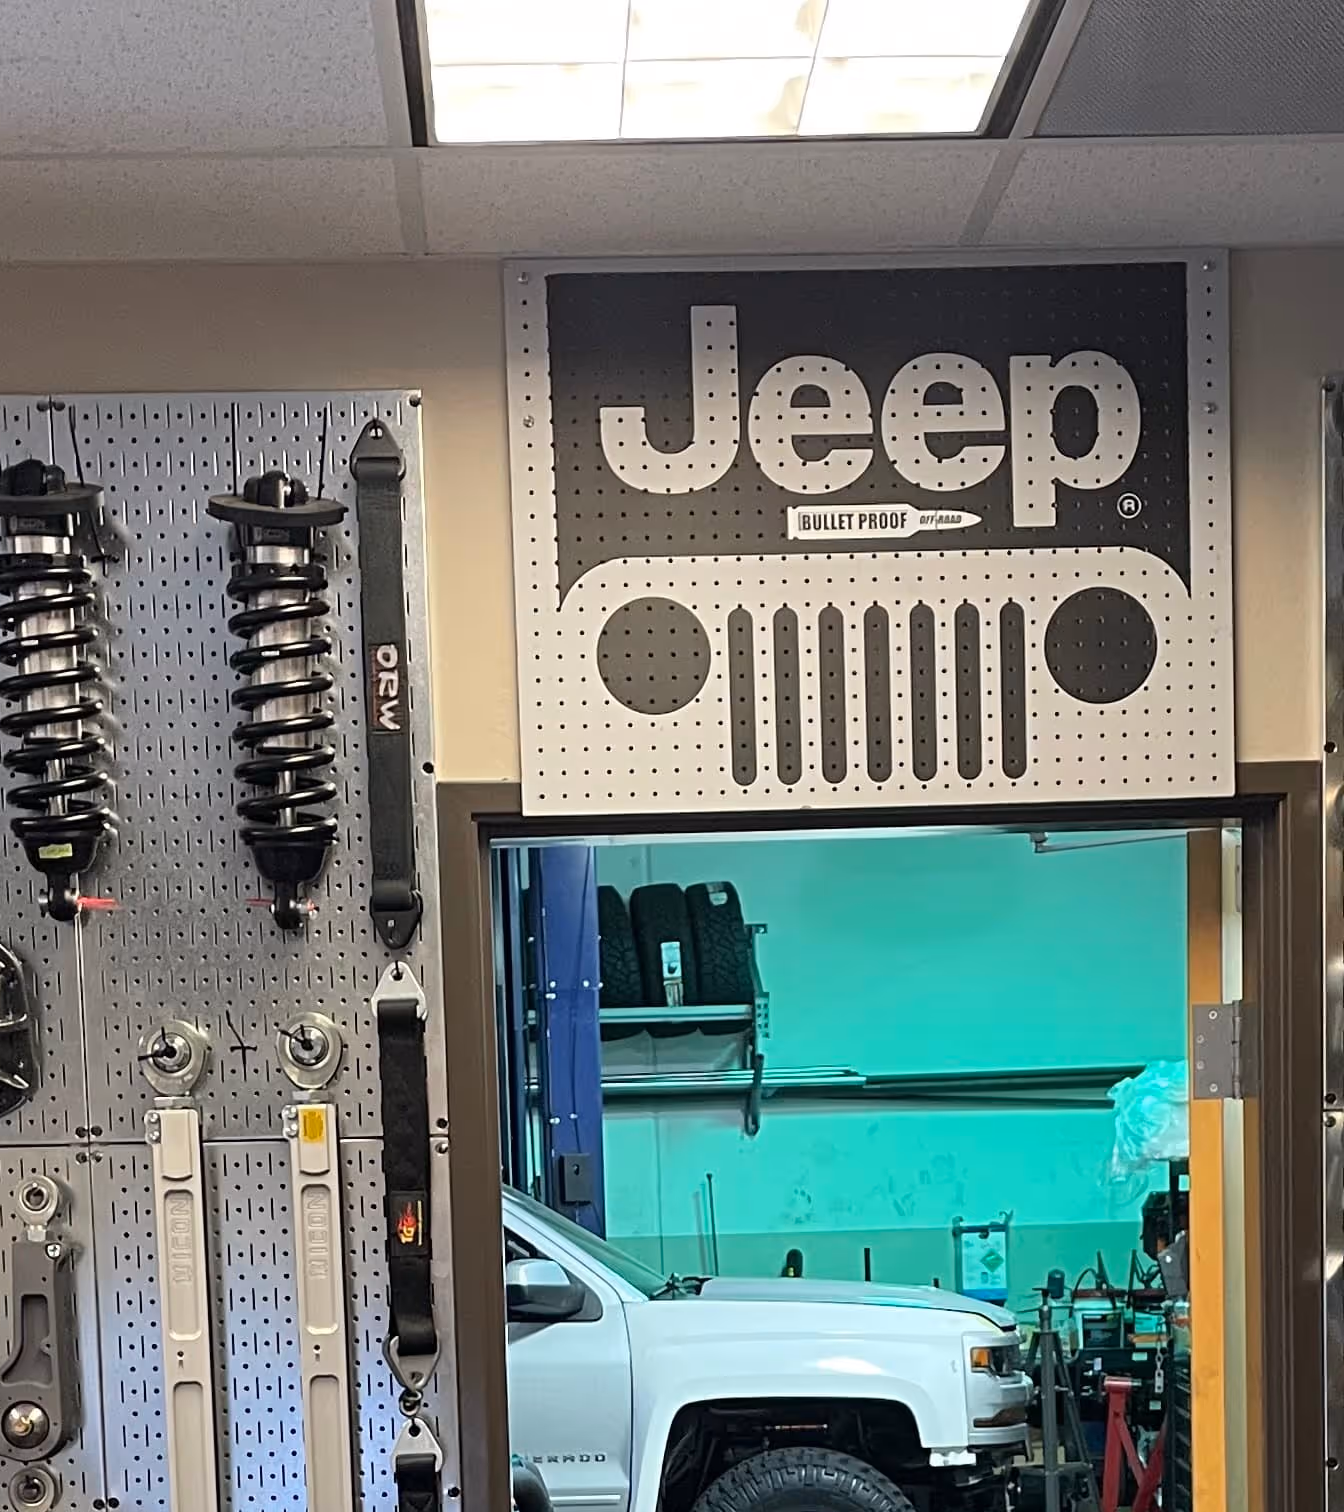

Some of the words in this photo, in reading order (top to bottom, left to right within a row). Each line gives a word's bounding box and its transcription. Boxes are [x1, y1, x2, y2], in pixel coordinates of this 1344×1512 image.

[600, 304, 1141, 527] Jeep
[800, 511, 854, 533] BULLET
[858, 510, 908, 532] PROOF
[376, 643, 401, 731] ORW
